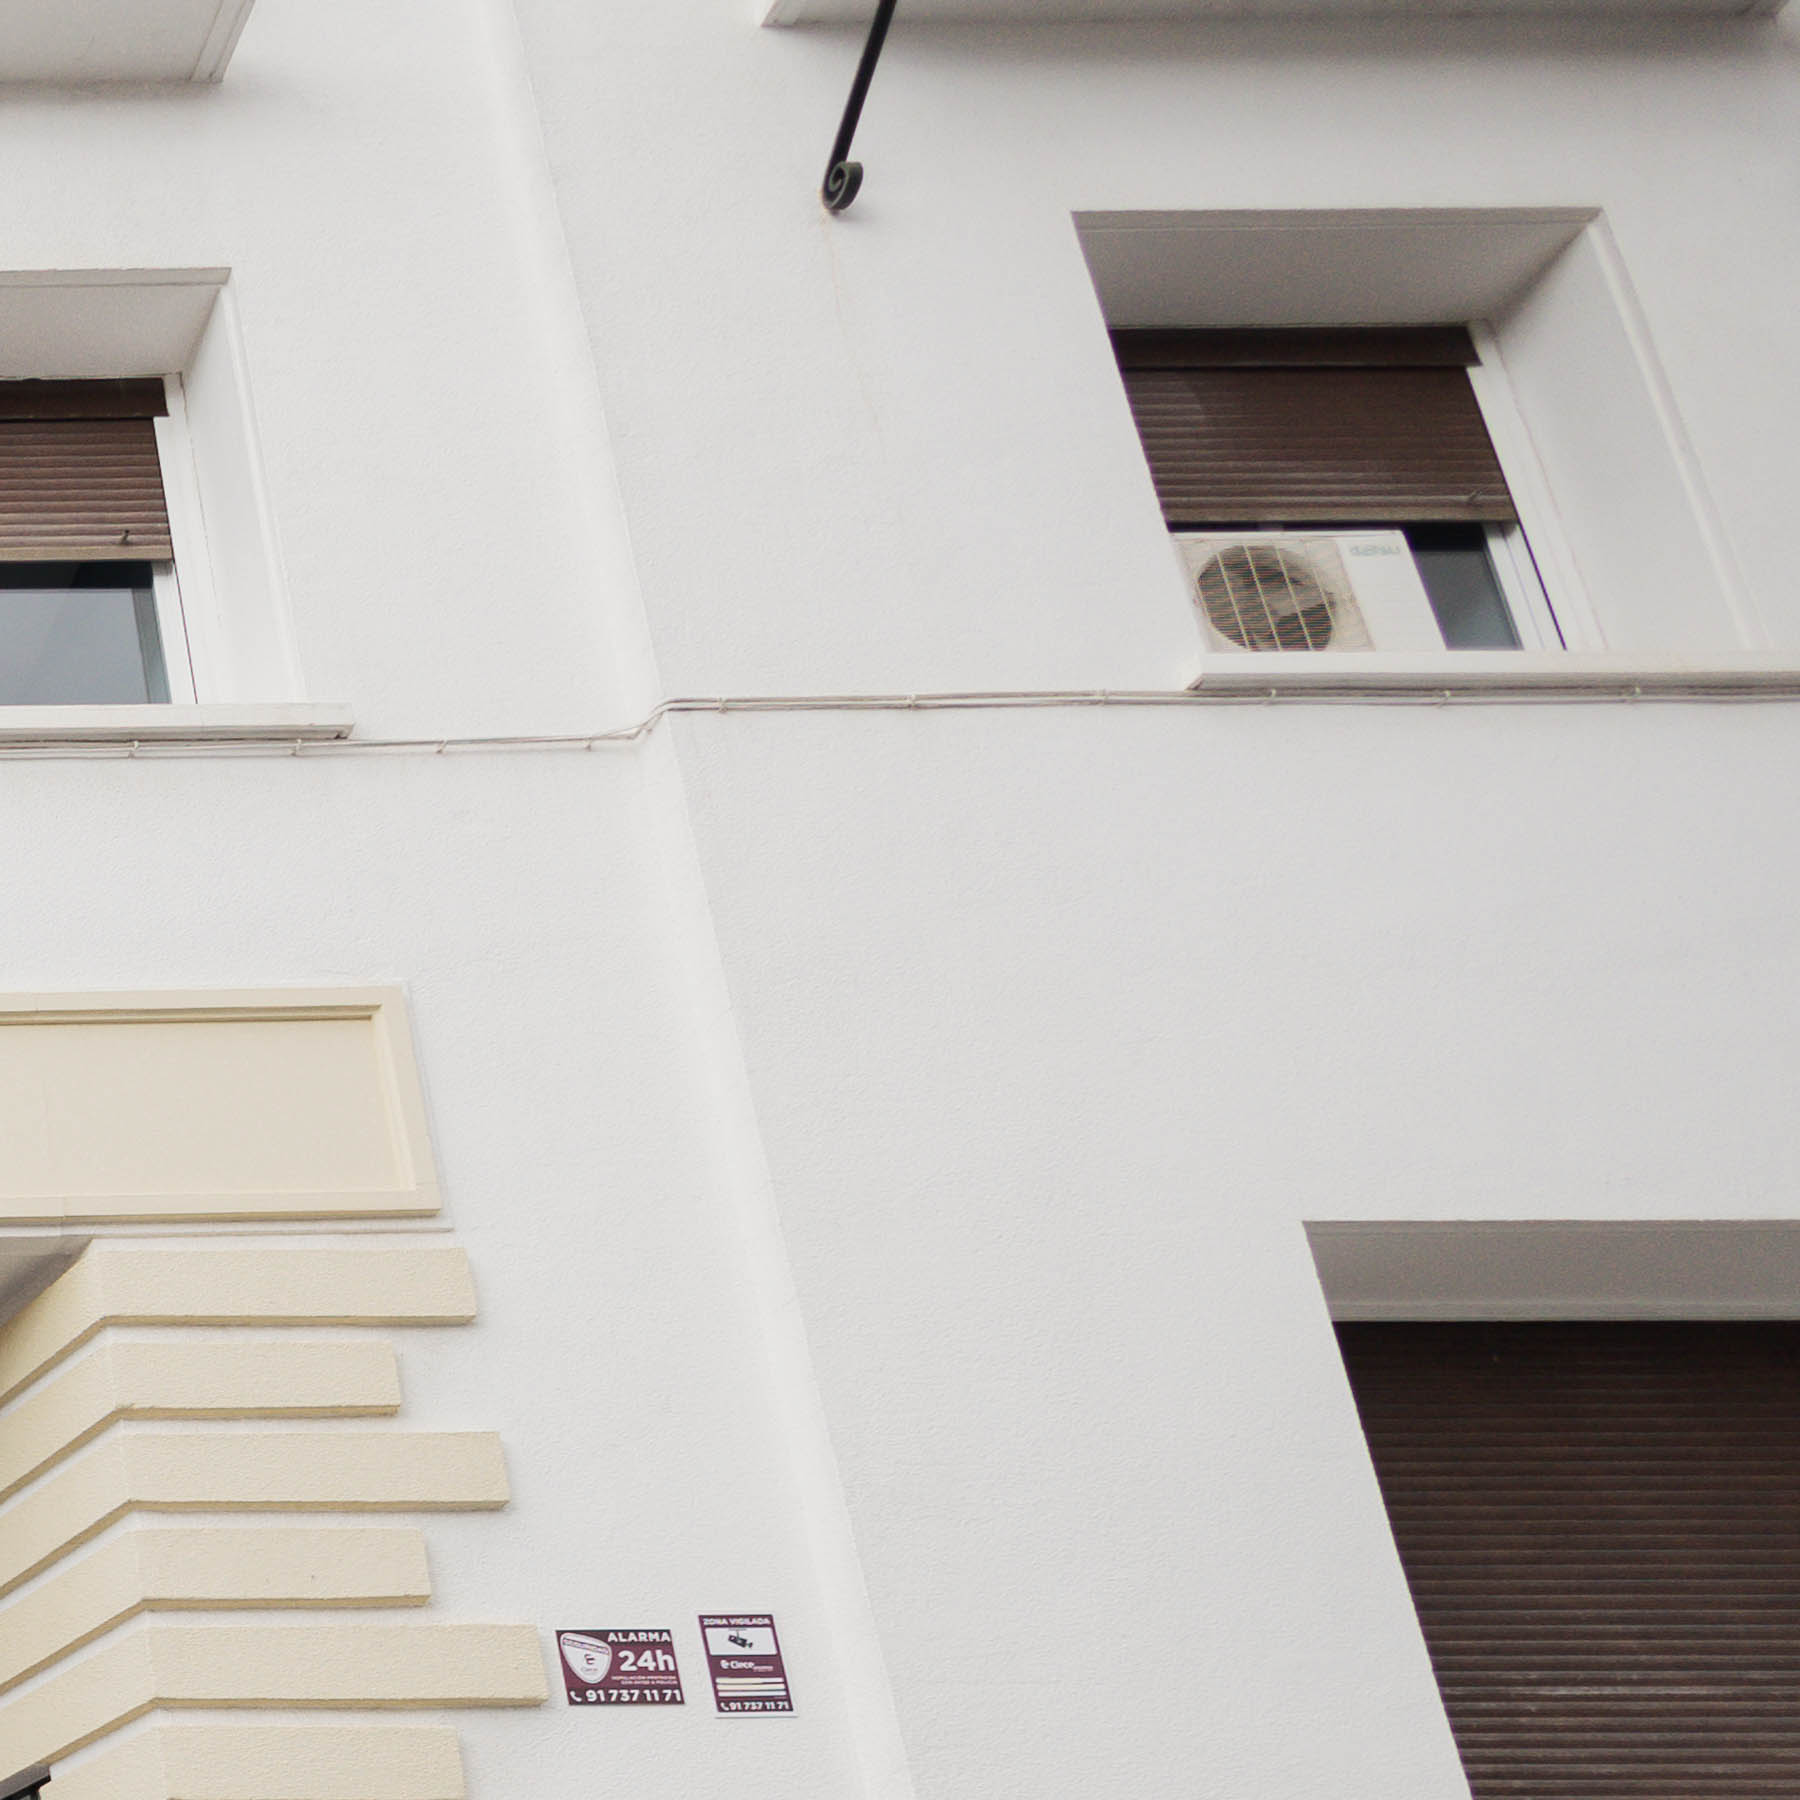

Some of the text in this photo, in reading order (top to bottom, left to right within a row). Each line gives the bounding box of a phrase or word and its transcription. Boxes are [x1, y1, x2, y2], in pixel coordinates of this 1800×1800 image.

[607, 1632, 671, 1643] ALARMA
[618, 1649, 675, 1672] 24h
[585, 1689, 682, 1702] 91 737 11 71
